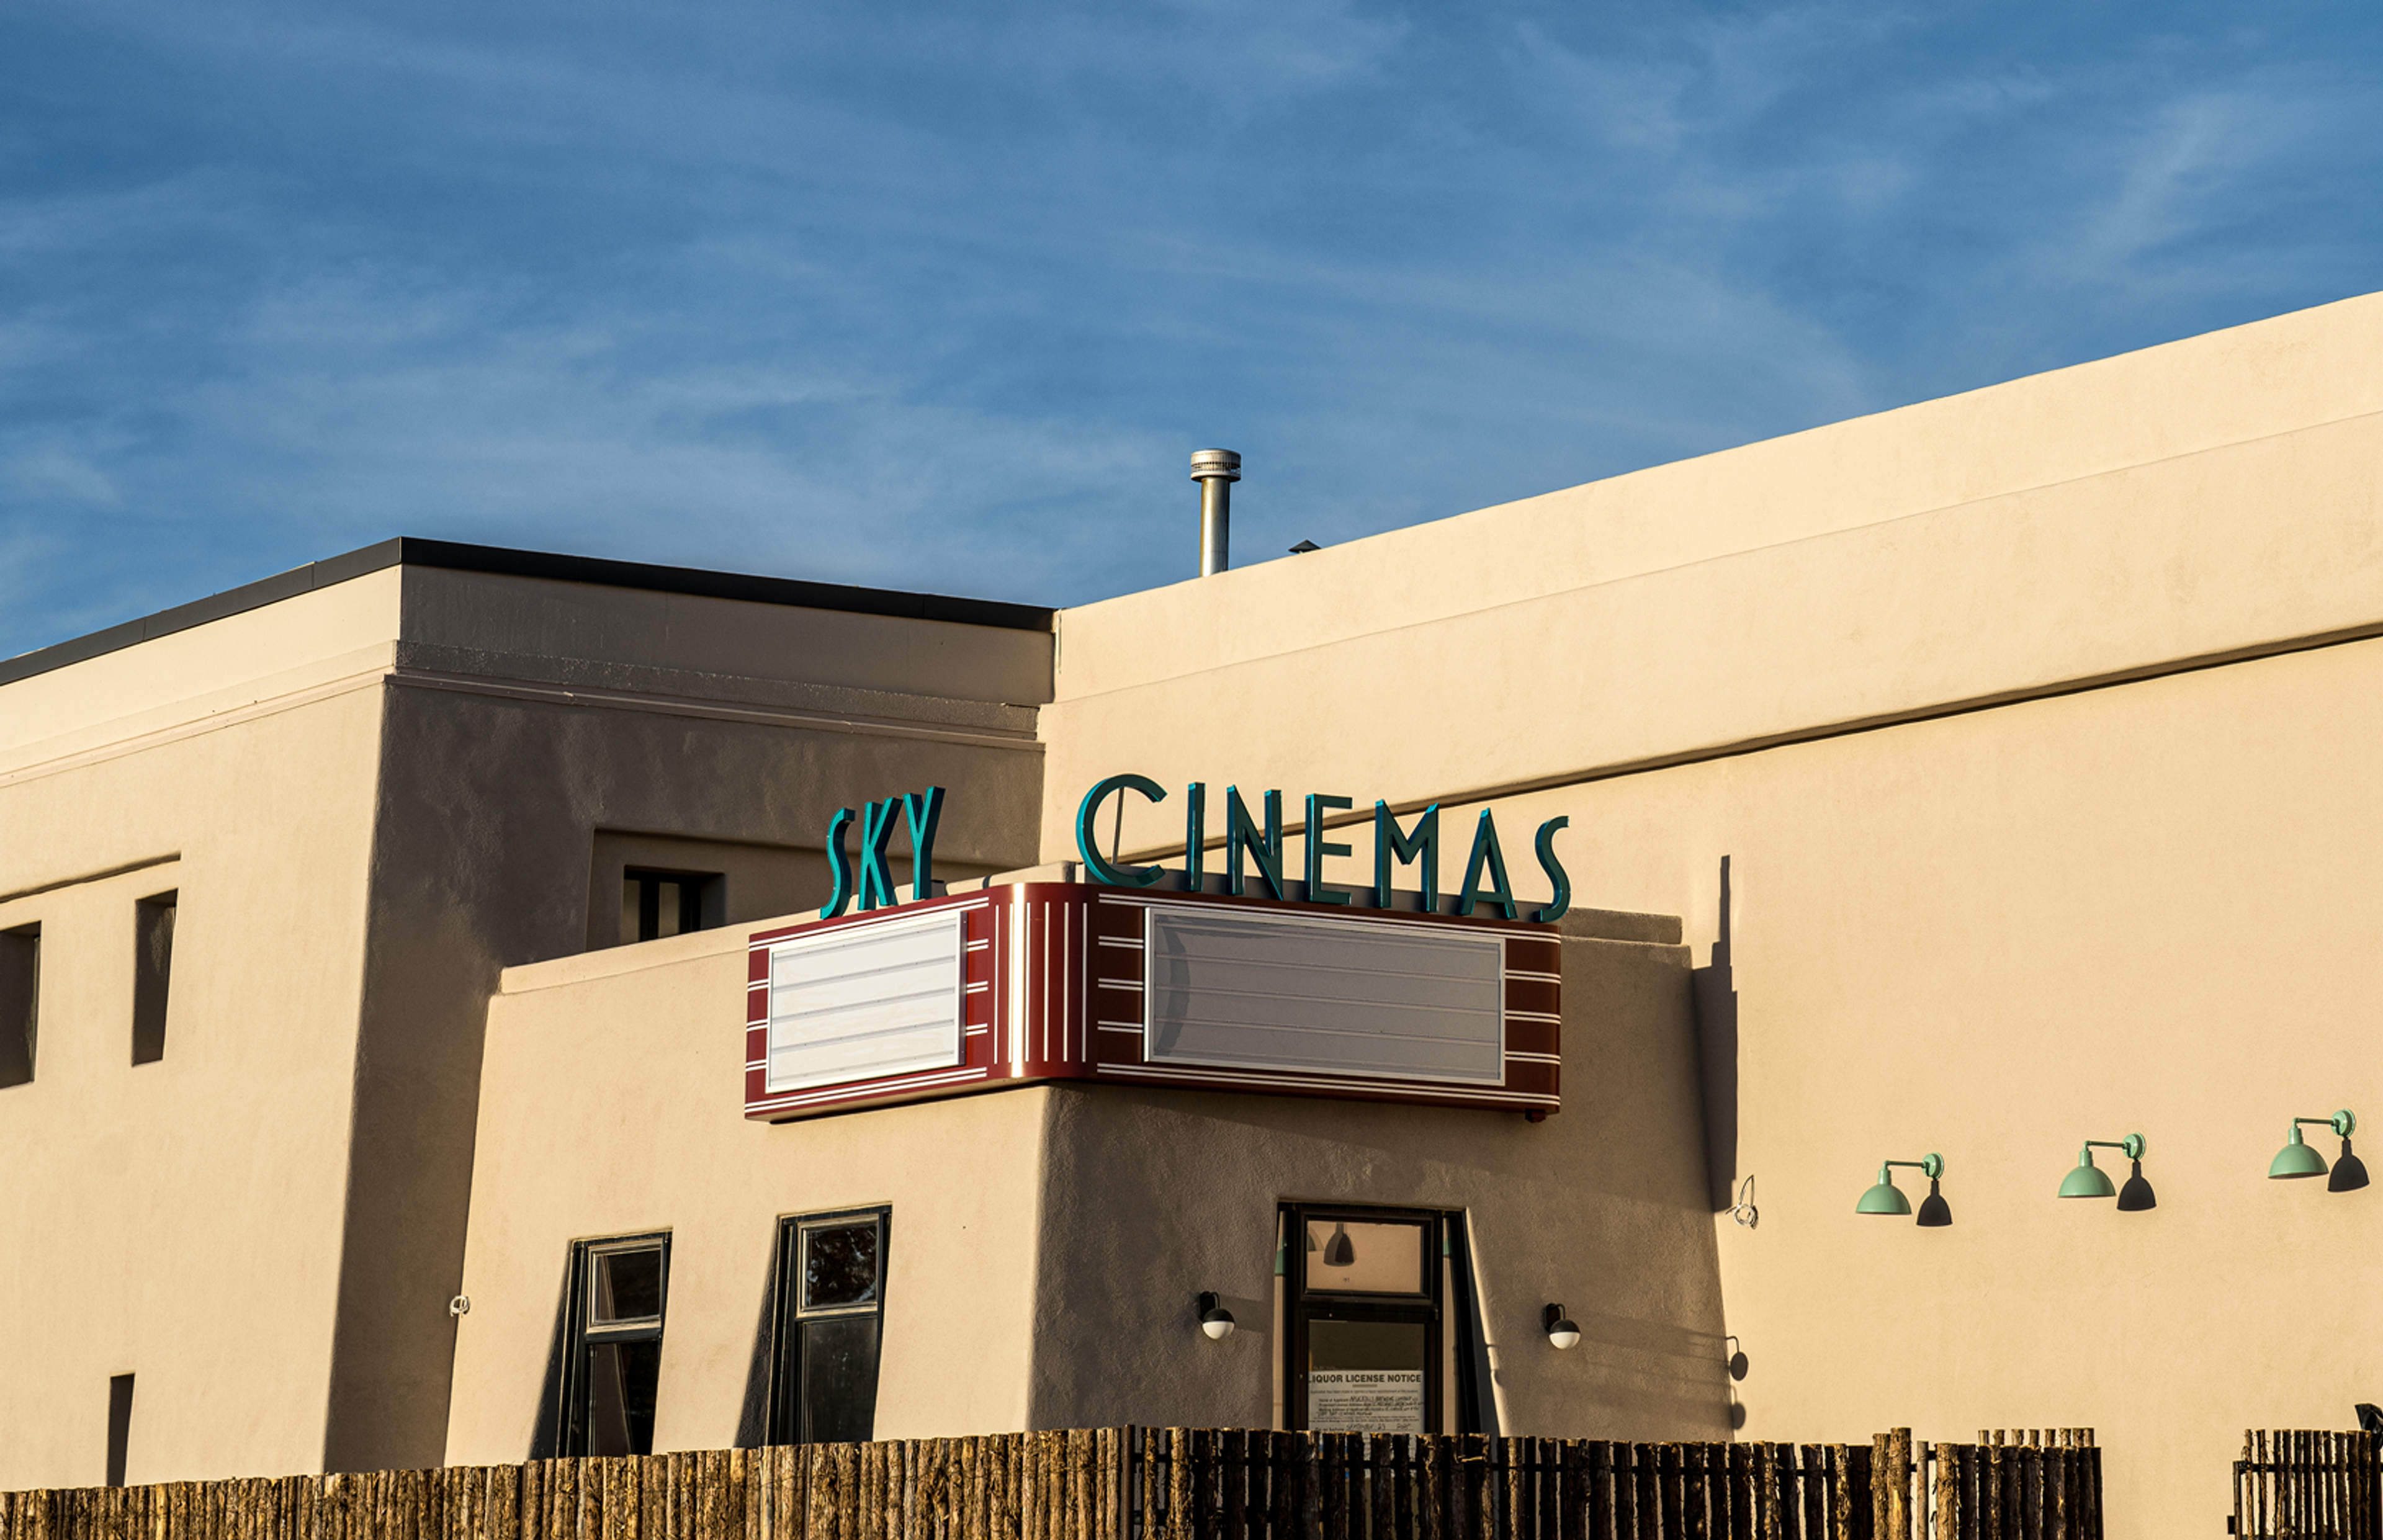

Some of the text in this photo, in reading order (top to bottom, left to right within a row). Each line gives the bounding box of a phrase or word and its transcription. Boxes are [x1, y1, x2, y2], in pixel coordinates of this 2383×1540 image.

[820, 774, 1571, 923] SKY CINEMAS
[1346, 1374, 1384, 1382] LICENSE
[1388, 1374, 1421, 1382] NOTICE
